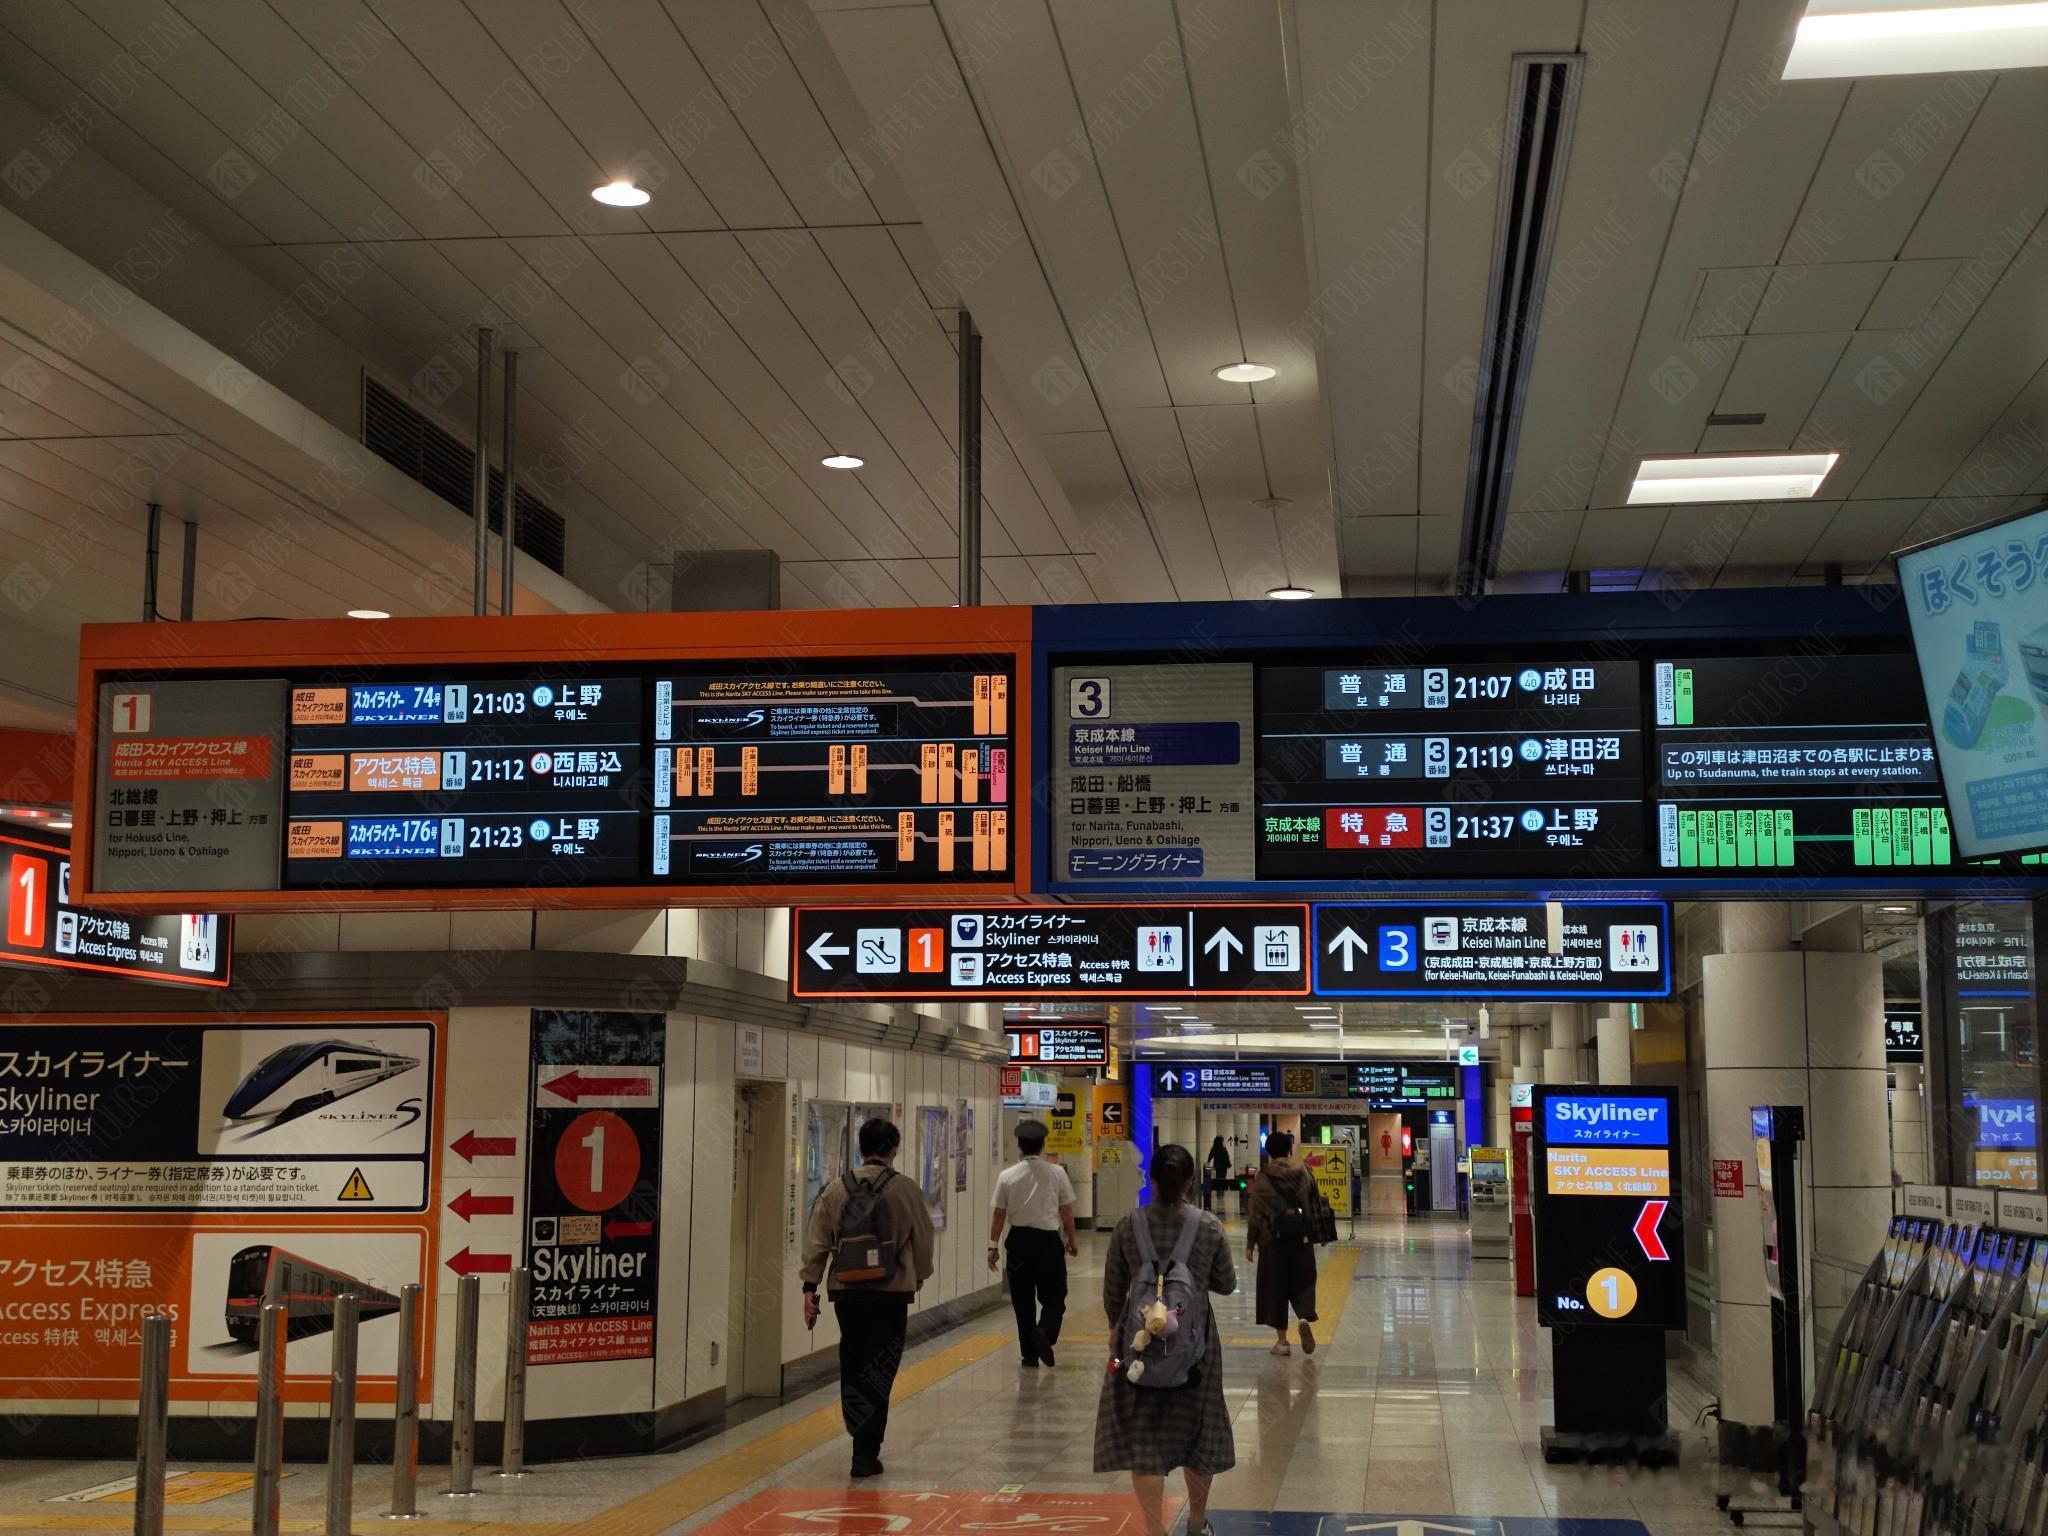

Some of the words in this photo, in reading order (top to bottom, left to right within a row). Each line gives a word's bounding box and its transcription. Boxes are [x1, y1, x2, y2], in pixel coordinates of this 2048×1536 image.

[1339, 674, 1407, 694] 普通
[1428, 672, 1444, 693] 3
[1455, 676, 1512, 699] 21:07
[1543, 668, 1595, 691] 成田
[473, 693, 525, 714] 21:03
[554, 684, 602, 707] 上野
[1078, 681, 1102, 716] 3
[1544, 693, 1581, 706] 나리타
[122, 697, 137, 730] 1
[554, 710, 587, 721] 우에노
[1075, 728, 1135, 743] 京成本線
[115, 741, 248, 757] 成田スカイアクセス線
[1075, 745, 1103, 754] Keisei
[1106, 745, 1127, 754] Main
[1130, 745, 1150, 753] Line
[1340, 743, 1407, 763] 普通
[1429, 742, 1445, 762] 3
[1456, 746, 1513, 769] 21:19
[1544, 738, 1620, 760] 津田沼
[1667, 748, 1935, 765] この列車は津田沼までの各駅に止まりま
[115, 758, 143, 767] Narita
[145, 758, 165, 767] SKY
[168, 758, 208, 766] ACCESS
[211, 758, 231, 766] Line
[353, 757, 437, 776] アクセス特急
[471, 759, 524, 781] 21:12
[553, 751, 622, 774] 西馬込
[1545, 764, 1595, 776] 쓰다누마
[553, 775, 608, 788] 니시마고메
[1667, 769, 1681, 780] Up
[1684, 770, 1695, 778] to
[1699, 769, 1759, 779] Tsudanuma,
[1762, 768, 1779, 777] the
[1781, 767, 1805, 777] train
[1808, 767, 1836, 777] stops
[1838, 767, 1849, 776] at
[1851, 767, 1879, 778] every
[1882, 766, 1922, 776] station.
[1070, 775, 1151, 793] 成田・船橋
[110, 789, 158, 806] 北総線
[1071, 797, 1212, 815] 日暮里・上野・押上
[1219, 802, 1240, 814] 方面
[248, 814, 268, 825] 方面
[1072, 820, 1087, 831] for
[1089, 820, 1124, 832] Narita,
[1126, 820, 1184, 832] Funabashi,
[1265, 817, 1321, 832] 京成本線
[1341, 813, 1408, 833] 特急
[1430, 811, 1447, 832] 3
[1456, 816, 1514, 839] 21:37
[1546, 808, 1598, 831] 上野
[109, 832, 123, 843] for
[469, 826, 522, 848] 21:23
[551, 818, 600, 841] 上野
[1071, 836, 1112, 848] Nippori,
[1115, 836, 1143, 845] Ueno
[1157, 835, 1200, 848] Oshiage
[1546, 834, 1583, 846] 우에노
[108, 847, 147, 859] Nippori,
[150, 847, 176, 858] Ueno
[188, 846, 230, 860] Oshiage
[551, 843, 585, 855] 우에노
[1071, 854, 1200, 872] モーニングライナー
[20, 867, 35, 936] 1
[79, 915, 130, 941] アクセス特急
[986, 914, 1086, 930] スカイライナー
[1462, 917, 1528, 933] 京成本線
[986, 933, 1040, 948] Skyliner
[1048, 934, 1099, 945] 스카이라이너
[1385, 930, 1409, 968] 3
[1462, 937, 1492, 950] Keisei
[1494, 937, 1522, 950] Main
[1524, 937, 1547, 949] Line
[78, 939, 106, 955] Access
[106, 942, 137, 961] Express
[918, 933, 931, 968] 1
[986, 953, 1072, 969] アクセス特急
[1080, 961, 1110, 970] Access
[986, 972, 1024, 984] Access
[1027, 972, 1071, 986] Express
[1424, 971, 1438, 982] (for
[1439, 970, 1487, 982] Keisei-Narita,
[1489, 970, 1548, 981] Keisei-Funabashi
[1556, 970, 1603, 981] Keisei-Ueno)
[1890, 1021, 1915, 1033] 号車
[1025, 1036, 1033, 1054] 1
[1899, 1034, 1920, 1047] 1-7
[0, 1050, 189, 1079] スカイライナー
[1185, 1072, 1195, 1088] 3
[0, 1086, 100, 1117] Skyliner
[1556, 1102, 1658, 1125] Skyliner
[1053, 1121, 1072, 1130] 出口
[1100, 1125, 1123, 1135] 出口
[1574, 1129, 1640, 1139] スカイライナー
[582, 1126, 605, 1192] 1
[1548, 1152, 1588, 1162] Narita
[1554, 1167, 1581, 1177] SKY
[1585, 1167, 1637, 1177] ACCESS
[1641, 1168, 1668, 1178] Line
[5, 1183, 36, 1192] Skyliner
[37, 1183, 62, 1192] tickets
[63, 1183, 98, 1193] (reserved
[99, 1184, 130, 1193] seating)
[145, 1183, 178, 1194] required
[189, 1183, 222, 1192] addition
[240, 1183, 274, 1192] standard
[1316, 1176, 1347, 1187] rminal
[533, 1246, 646, 1283] Skyliner
[534, 1284, 635, 1301] スカイライナー
[1558, 1297, 1584, 1310] No.
[1600, 1275, 1618, 1310] 1
[0, 1301, 71, 1321] ccess
[80, 1298, 179, 1327] Express
[590, 1300, 649, 1313] 스카이라이너
[530, 1325, 560, 1337] Narita
[563, 1323, 584, 1335] SKY
[588, 1320, 628, 1333] ACCESS
[632, 1320, 652, 1331] Line
[44, 1329, 79, 1347] 特快
